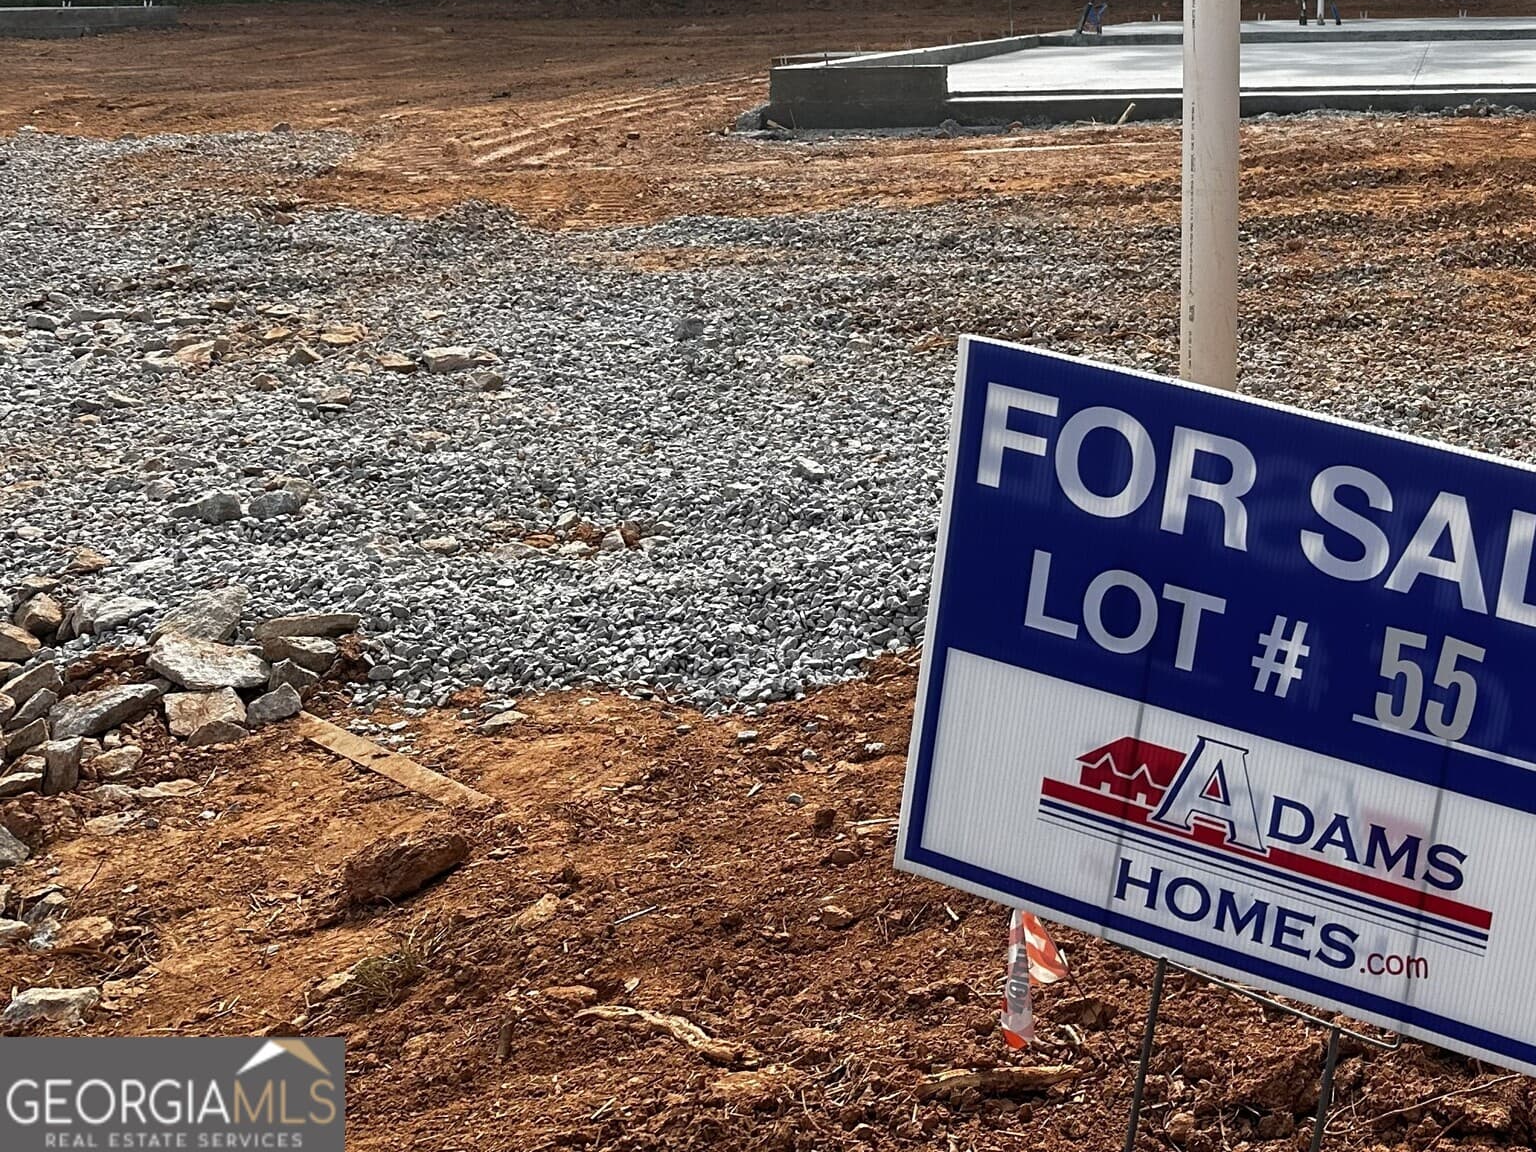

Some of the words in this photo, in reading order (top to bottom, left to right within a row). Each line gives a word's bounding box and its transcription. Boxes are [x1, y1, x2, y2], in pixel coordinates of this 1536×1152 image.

[976, 382, 1257, 551] FOR
[1024, 551, 1226, 672] LOT
[1251, 615, 1310, 698] #
[1374, 627, 1486, 741] 55
[1152, 736, 1468, 892] ADAMS
